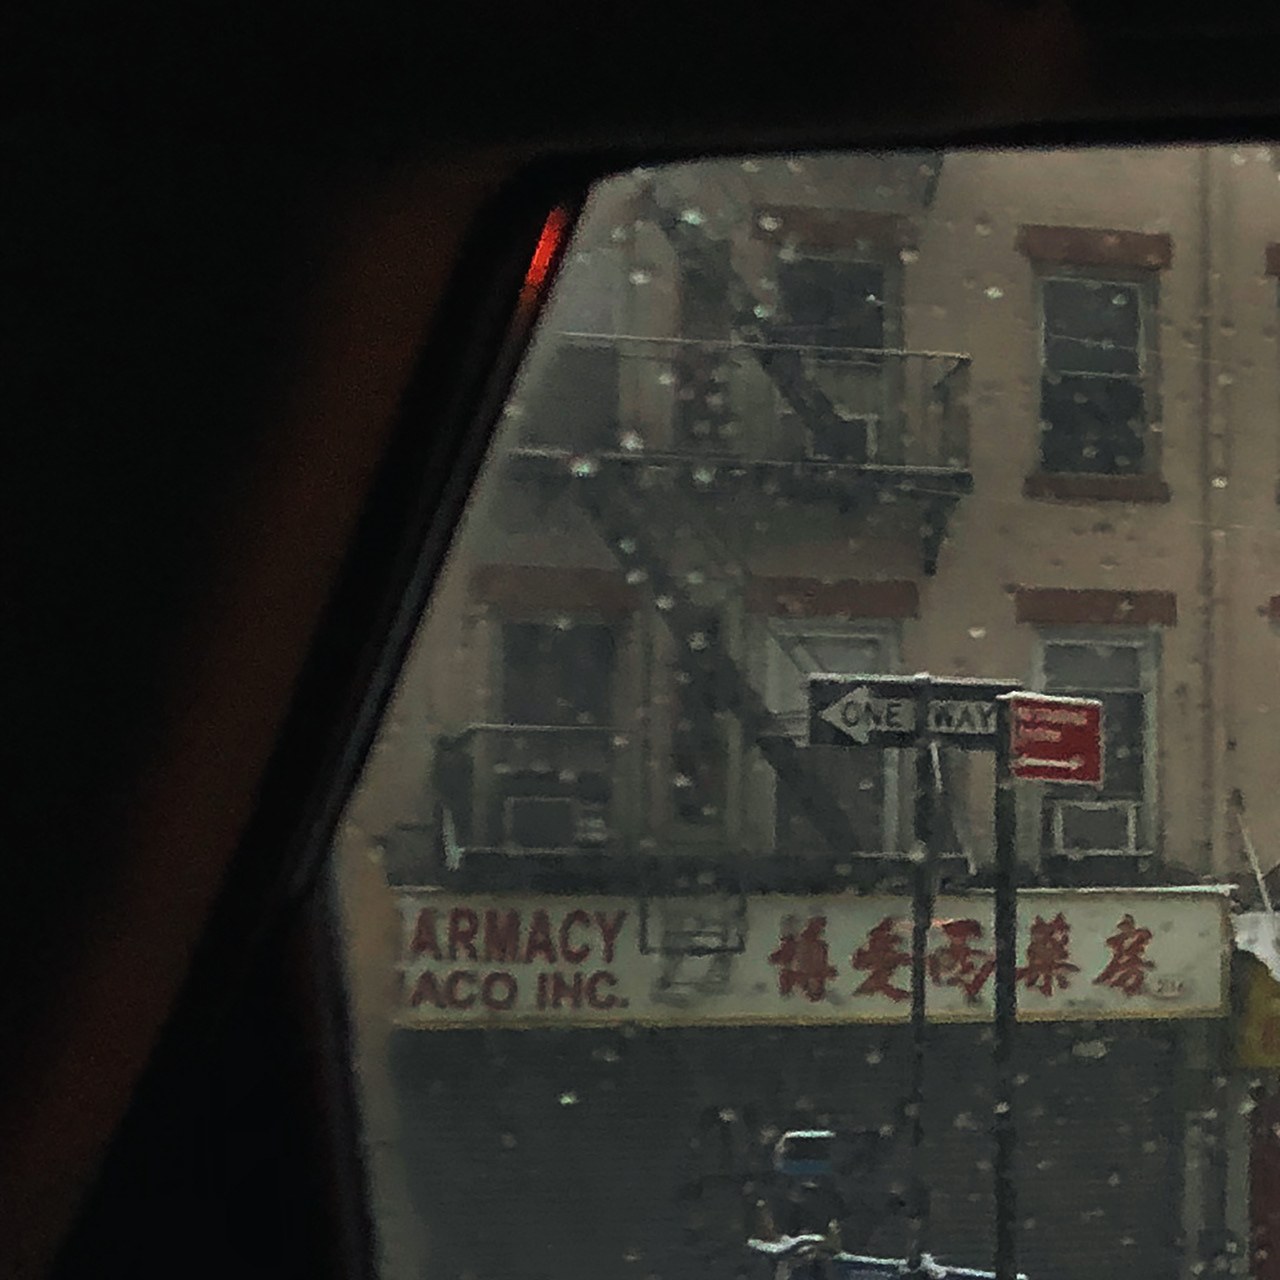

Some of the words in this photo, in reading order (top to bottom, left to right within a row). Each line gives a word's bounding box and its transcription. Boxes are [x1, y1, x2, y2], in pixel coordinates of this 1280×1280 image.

[841, 700, 903, 728] ONE
[932, 703, 995, 731] WAY
[398, 907, 628, 964] ARMACY
[398, 970, 518, 1010] ACO
